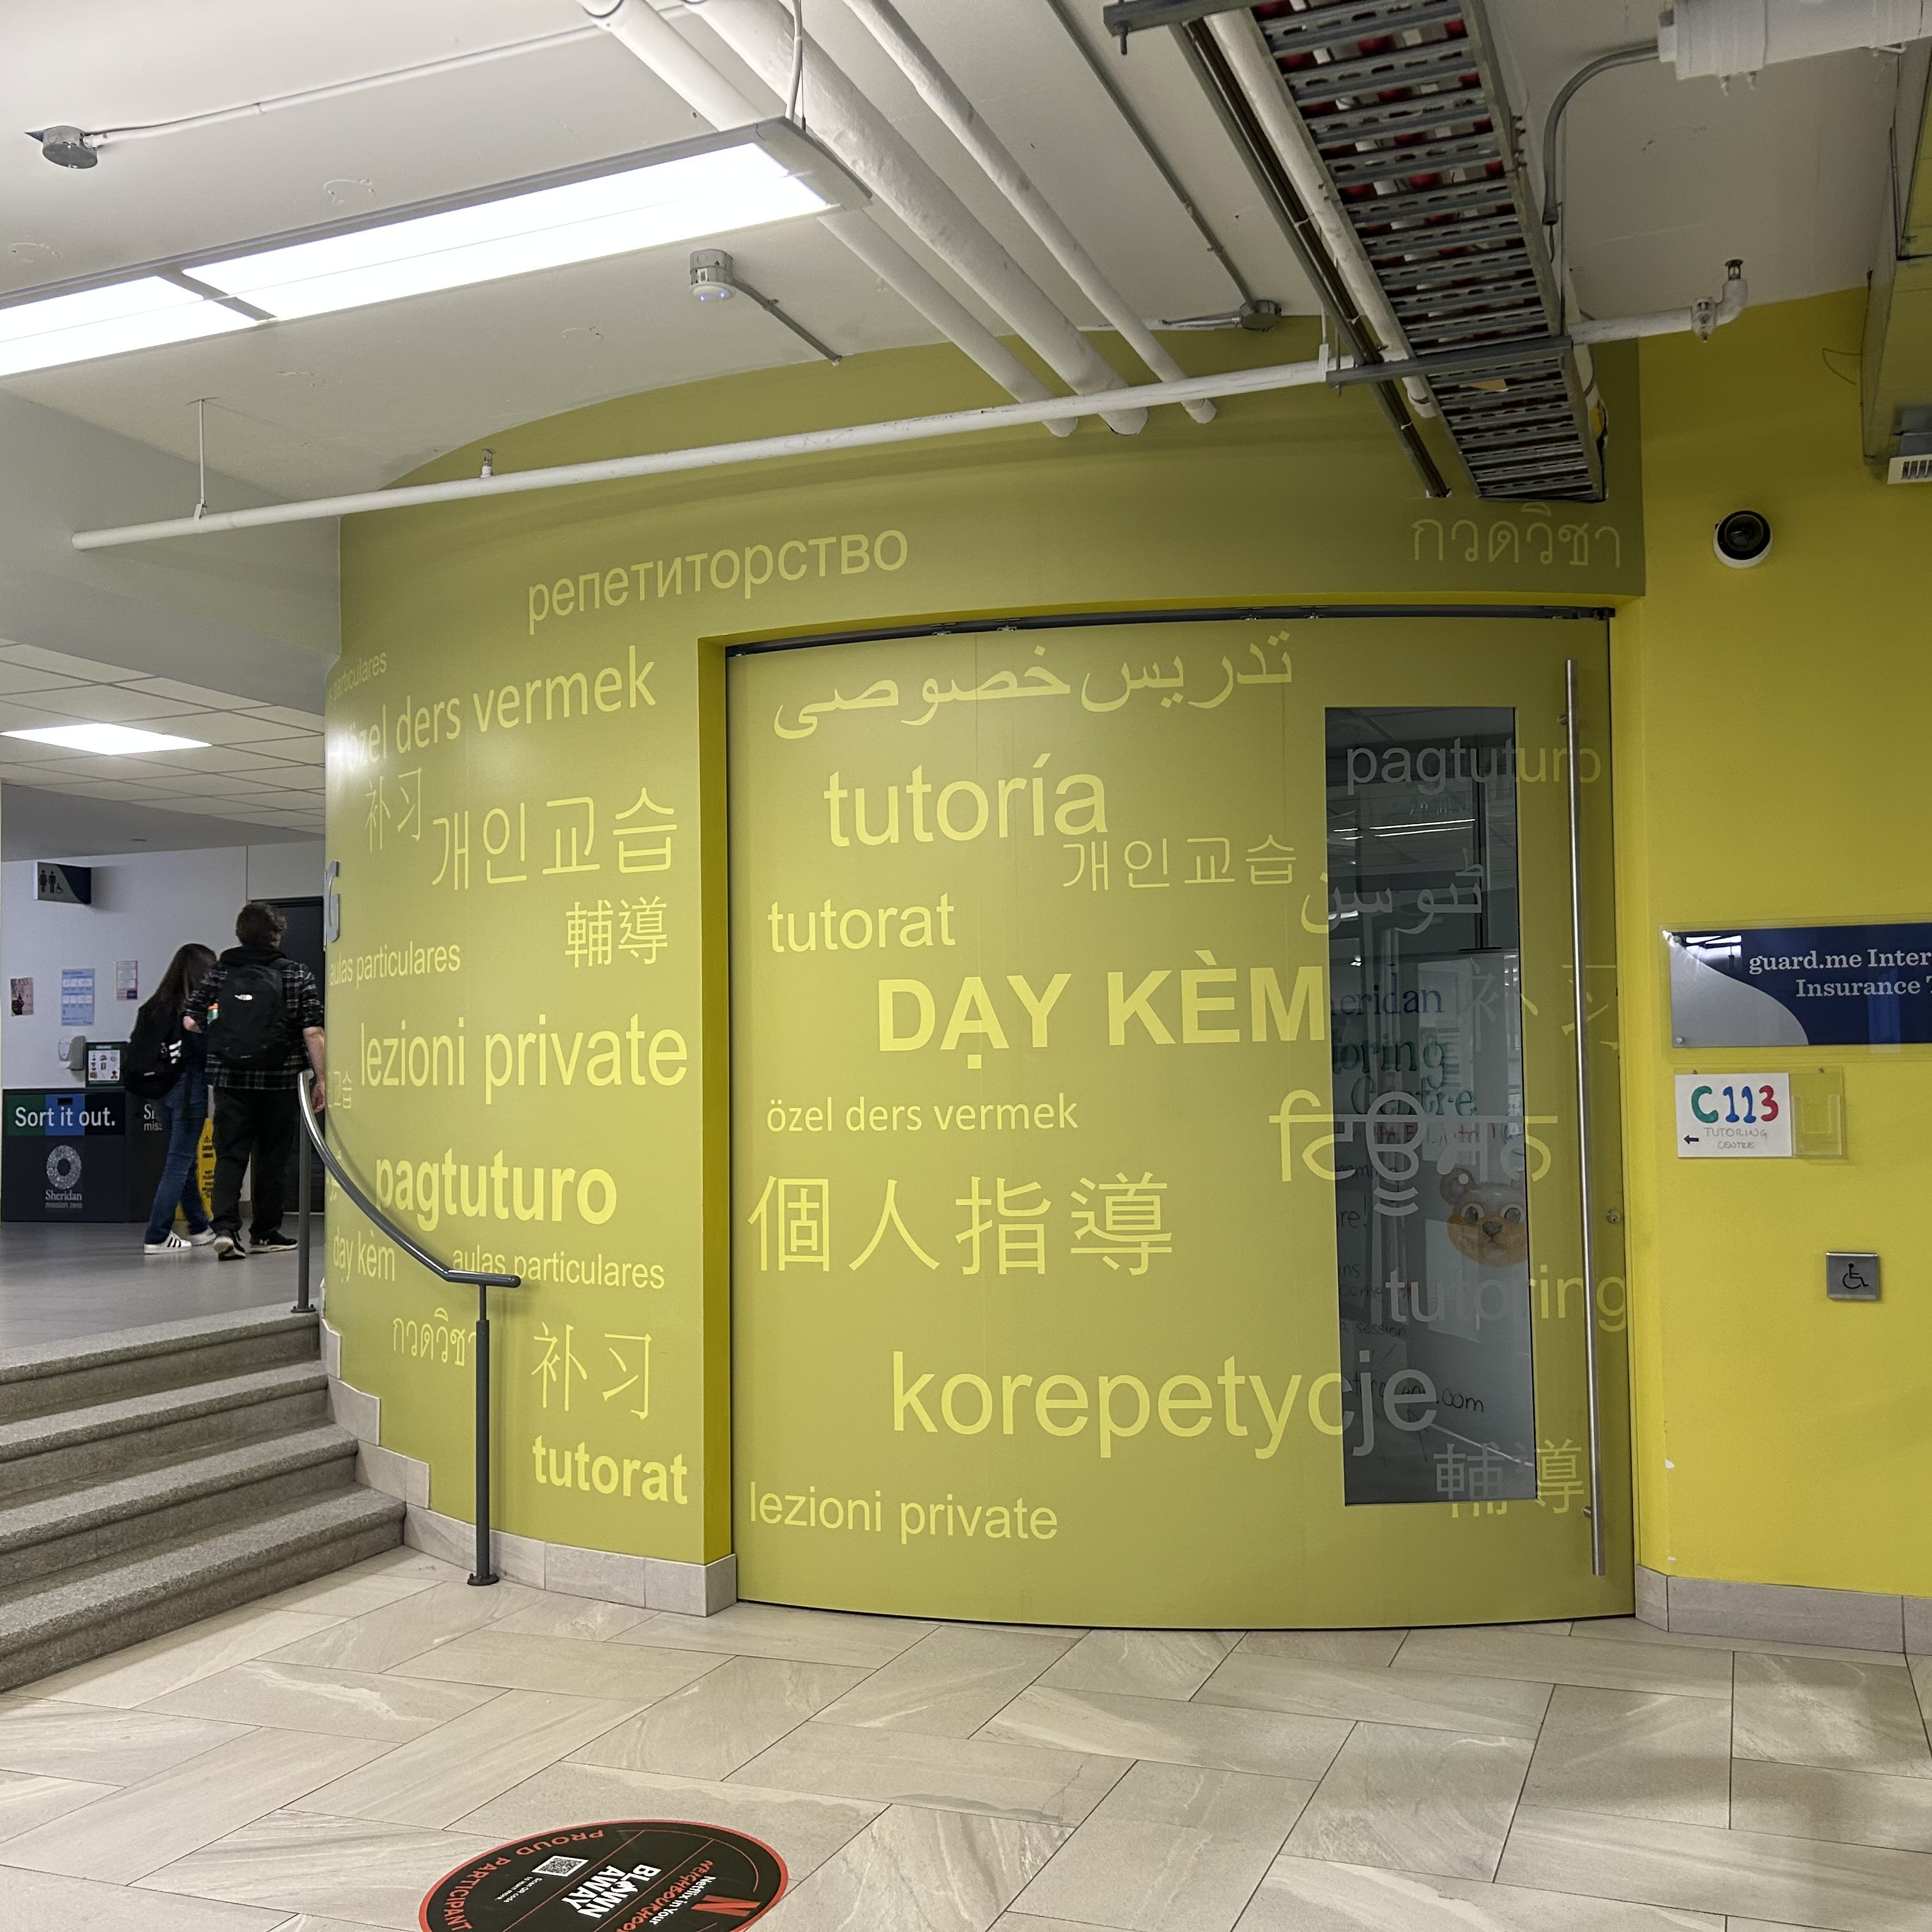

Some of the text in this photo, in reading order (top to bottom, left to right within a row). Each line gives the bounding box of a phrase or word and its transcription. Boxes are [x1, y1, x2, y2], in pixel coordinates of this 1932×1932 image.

[1411, 502, 1621, 568] กวดวิชา
[528, 529, 908, 635] репетиторство
[396, 695, 461, 753] ders
[473, 645, 656, 732] vermek
[1347, 737, 1601, 796] pagtuturo
[365, 767, 422, 853] 补习
[824, 753, 1108, 847] tutoría
[432, 788, 677, 890] 개인교습
[1062, 834, 1296, 891] 개인교습
[565, 895, 668, 968] 輔導
[768, 893, 955, 953] tutorat
[330, 941, 460, 988] aulas particulares
[1749, 950, 1862, 975] guard.me
[1795, 979, 1920, 997] Insurance
[878, 950, 1324, 1070] DẠY KÈM
[361, 1013, 687, 1105] lezioni private
[15, 1107, 116, 1127] Sort it out.
[767, 1093, 1078, 1133] özel ders vermek
[1704, 1127, 1768, 1140] TUTORING
[45, 1190, 82, 1201] Sheridan
[376, 1148, 617, 1232] pagtuturo
[358, 1230, 395, 1282] kèm
[747, 1172, 1172, 1276] 個人指導
[453, 1245, 664, 1289] aulas particulares
[532, 1321, 652, 1420] 补习
[893, 1350, 1437, 1460] korepetycje
[532, 1436, 687, 1505] tutorat
[749, 1482, 1058, 1544] lezioni private
[443, 1829, 604, 1931] PROUD PARTICIPANT
[561, 1865, 626, 1910] AWAY
[649, 1876, 716, 1925] Netflix in Your
